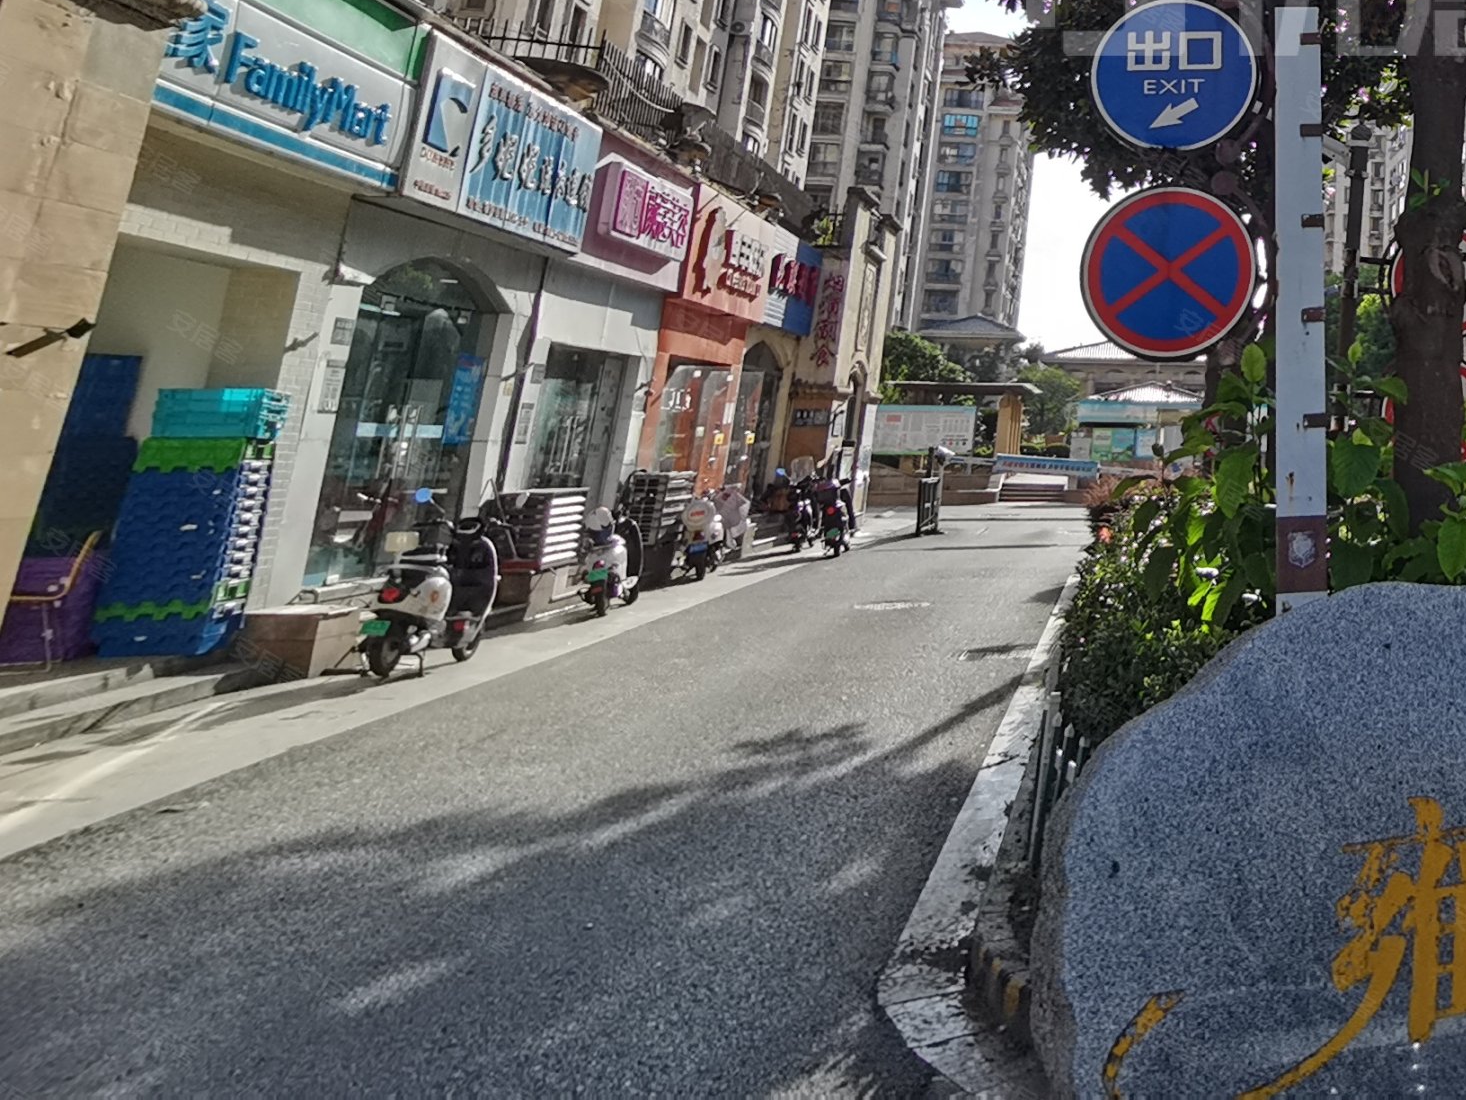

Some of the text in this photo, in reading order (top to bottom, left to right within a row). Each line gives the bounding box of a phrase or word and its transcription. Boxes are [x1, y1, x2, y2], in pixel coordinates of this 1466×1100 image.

[1127, 31, 1223, 71] 出口
[224, 31, 392, 146] FamilyMart
[1143, 78, 1205, 96] EXIT
